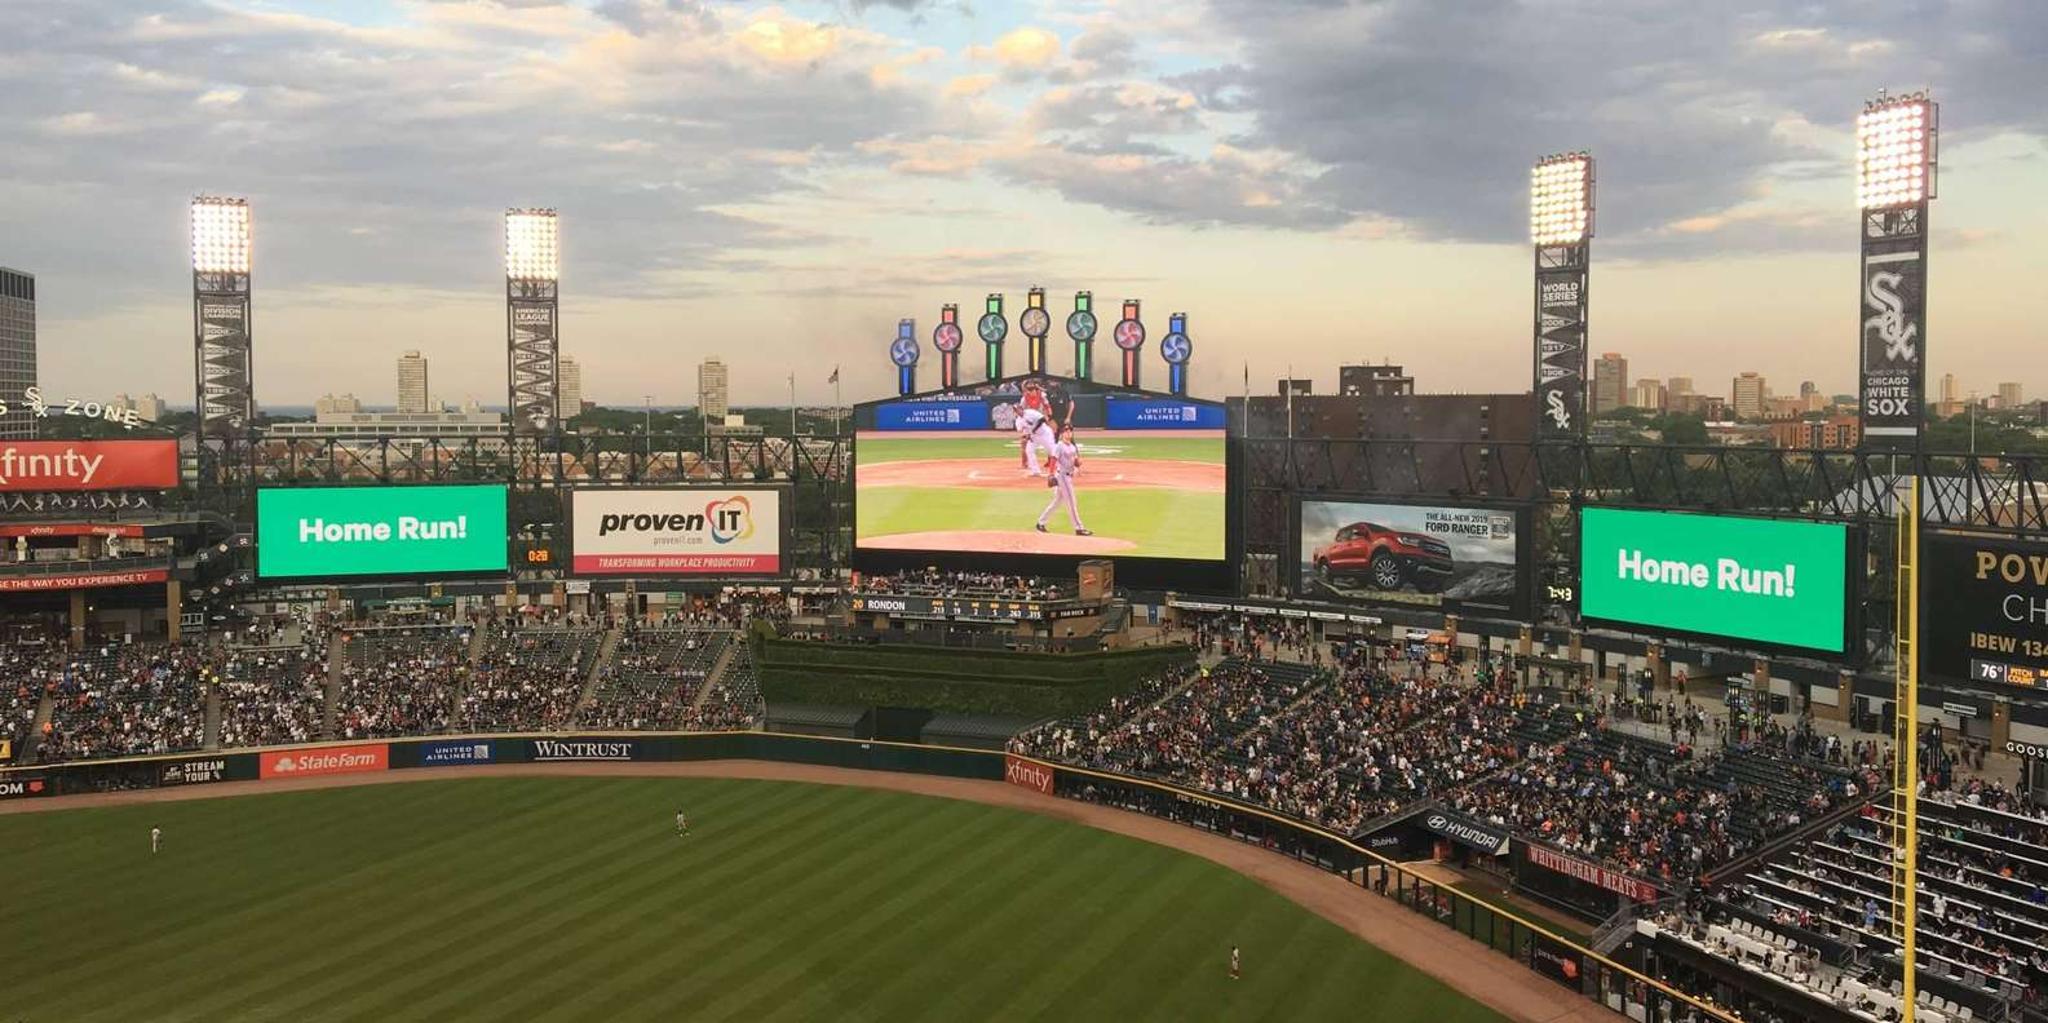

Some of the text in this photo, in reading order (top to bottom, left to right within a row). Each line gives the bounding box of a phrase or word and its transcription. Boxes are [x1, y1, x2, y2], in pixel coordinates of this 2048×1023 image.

[1543, 283, 1578, 293] WORLD
[1543, 291, 1578, 302] SERIES
[516, 313, 549, 321] LEAGUE
[1867, 376, 1909, 386] CHICAGO
[1867, 386, 1909, 398] WHITE
[64, 399, 139, 426] ZONE
[1145, 407, 1180, 415] UNITED
[1868, 398, 1909, 416] SOX
[600, 510, 741, 537] proven IT
[1425, 512, 1438, 520] THE
[298, 515, 467, 543] Home Run!
[1425, 521, 1450, 533] FORD
[1451, 523, 1489, 536] RANGER
[599, 557, 756, 569] TRANSFORMING WORKPLACE PRODUCTIVITY
[1617, 547, 1796, 598] Home Run!
[12, 580, 31, 589] THE
[32, 579, 53, 588] WAY
[55, 577, 76, 587] YOU
[78, 574, 135, 585] EXPERIENCE
[136, 573, 148, 582] TV
[1547, 585, 1572, 601] 7:43
[867, 600, 906, 611] RONDON
[1970, 632, 2015, 654] IBEW
[435, 746, 472, 754] UNITED
[534, 741, 631, 757] WINTRUST
[2006, 742, 2048, 758] GOOS
[184, 761, 225, 773] STREAM
[184, 771, 210, 782] YOUR
[1007, 763, 1051, 793] xfinity
[1445, 821, 1499, 849] HYUNDAI
[1529, 846, 1638, 898] WHITTINGHAM MEATS
